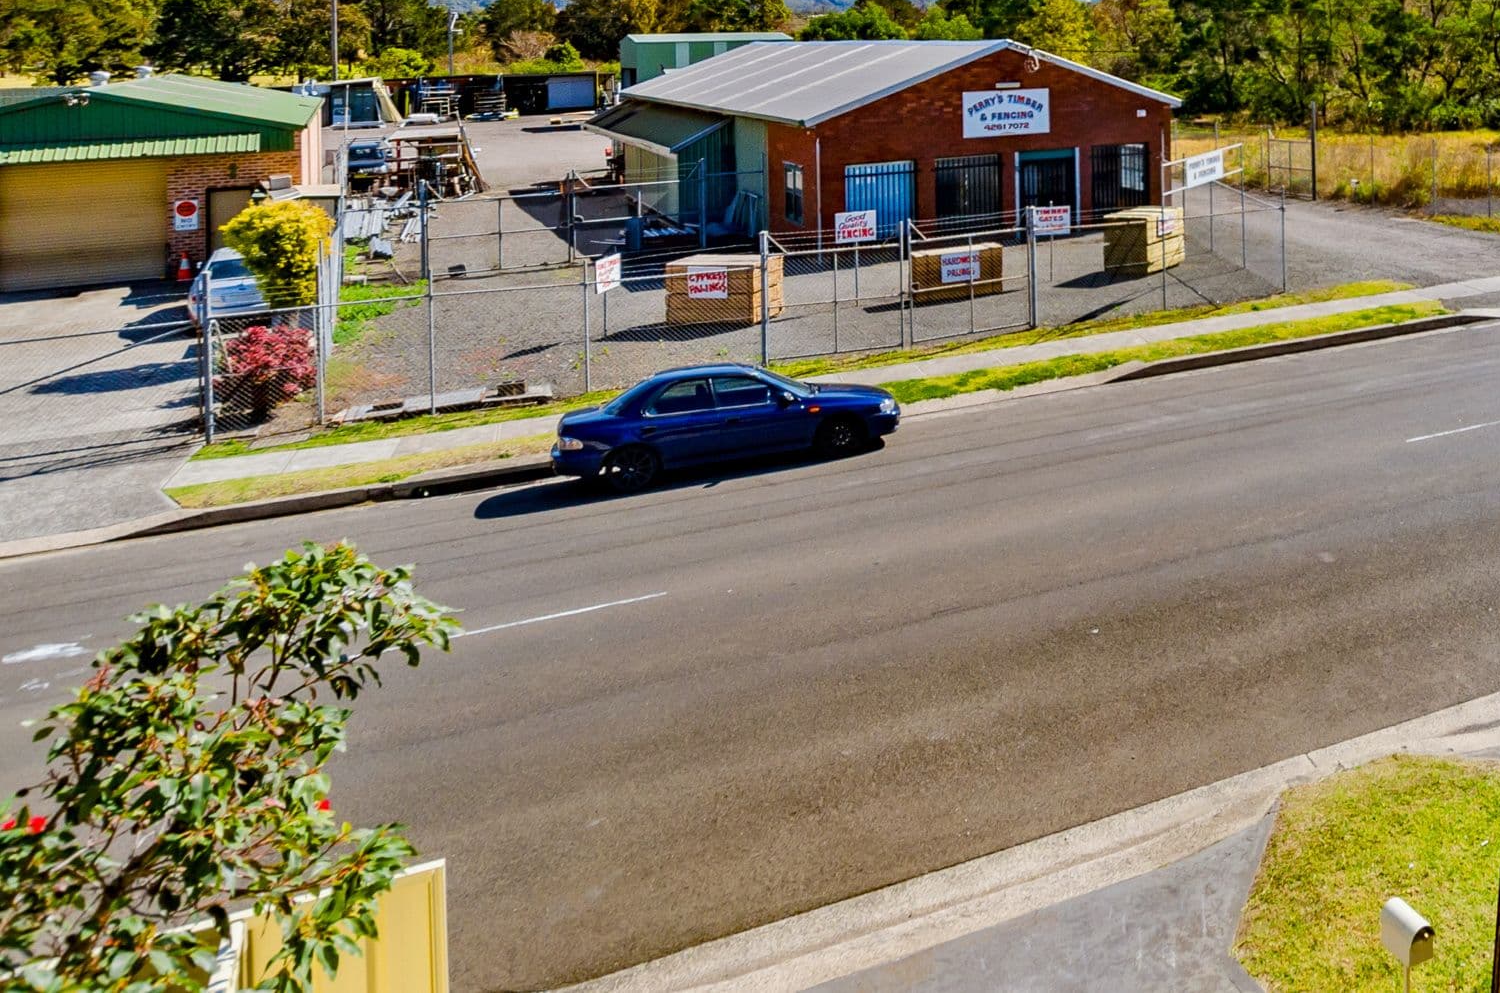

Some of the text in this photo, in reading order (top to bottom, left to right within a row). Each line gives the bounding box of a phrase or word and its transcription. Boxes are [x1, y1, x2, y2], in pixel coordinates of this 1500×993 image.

[967, 93, 1044, 117] PERRY'S TIMBER
[980, 110, 1034, 122] & FENCING
[845, 213, 866, 223] Good
[837, 227, 874, 240] FENCING
[689, 270, 726, 283] CYPRESS
[689, 282, 727, 295] PALINGS
